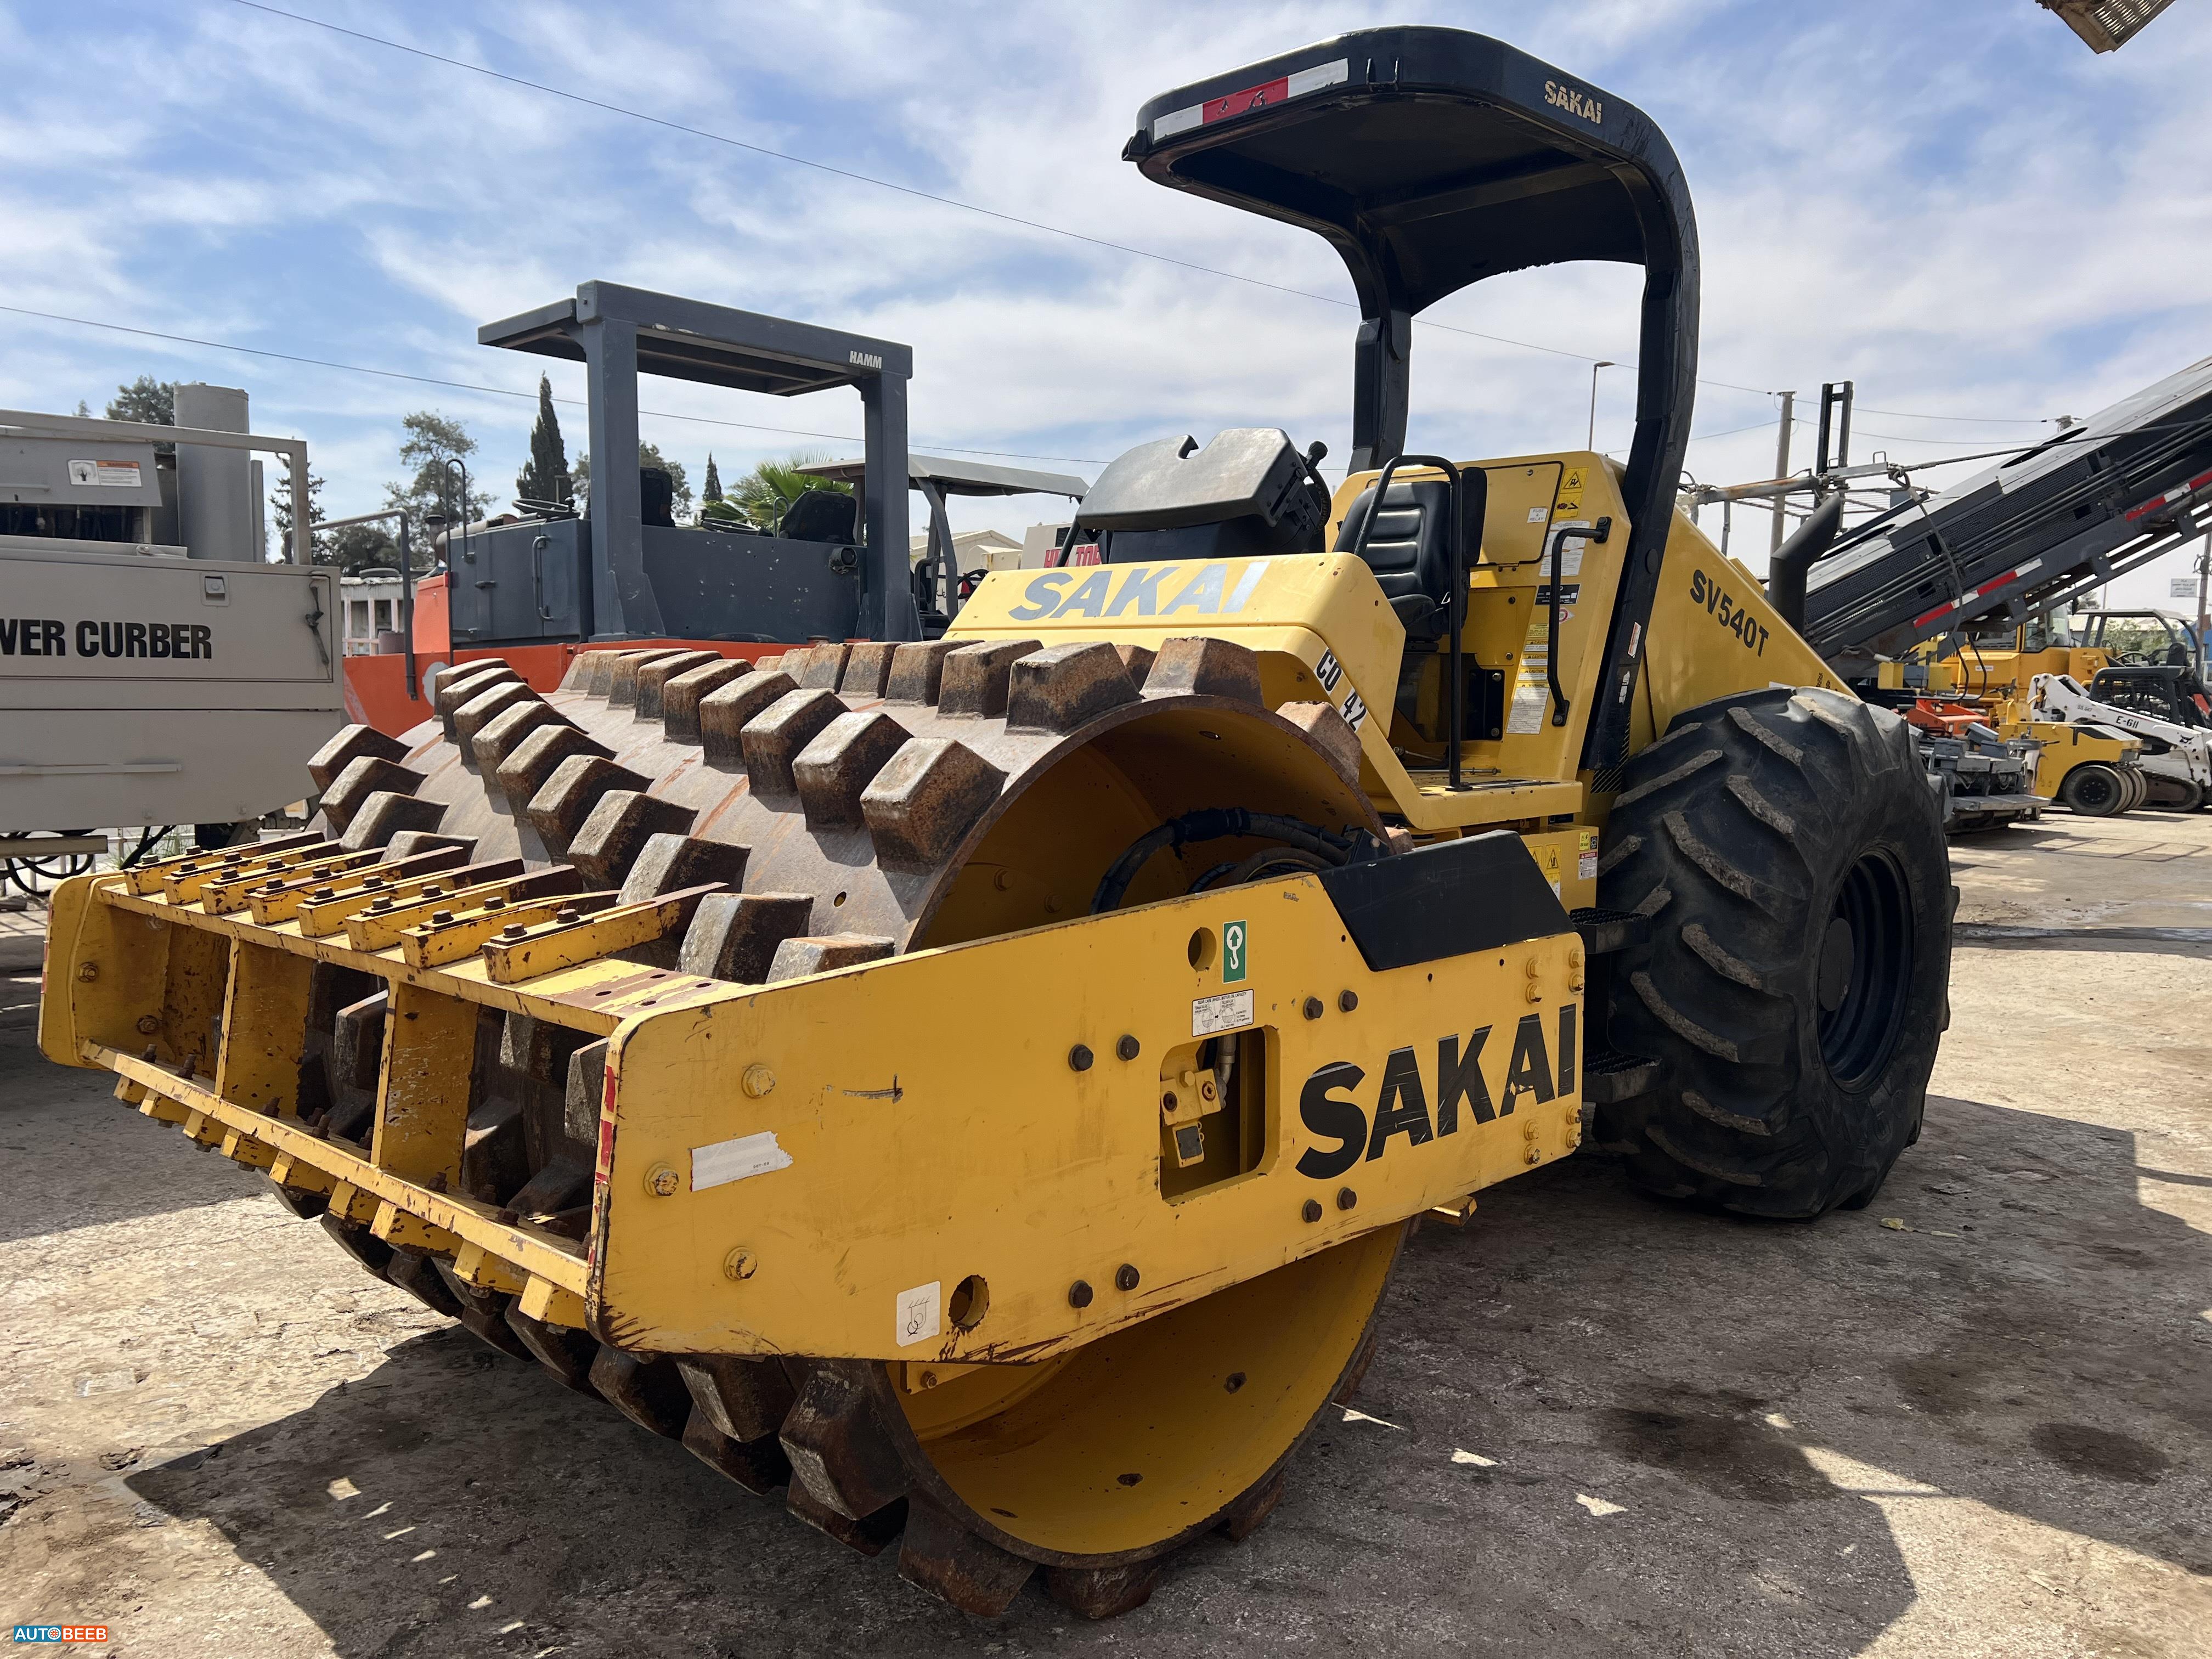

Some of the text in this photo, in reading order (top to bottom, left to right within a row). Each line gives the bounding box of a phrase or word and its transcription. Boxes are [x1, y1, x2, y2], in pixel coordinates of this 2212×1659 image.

[1544, 81, 1602, 124] SAKAI
[849, 351, 882, 369] HAMM
[1008, 561, 1270, 621] SAKAI
[1690, 569, 1769, 658] SV540T
[75, 620, 212, 659] CURBER
[1316, 649, 1367, 731] CO 42
[1295, 1003, 1577, 1180] SAKAI
